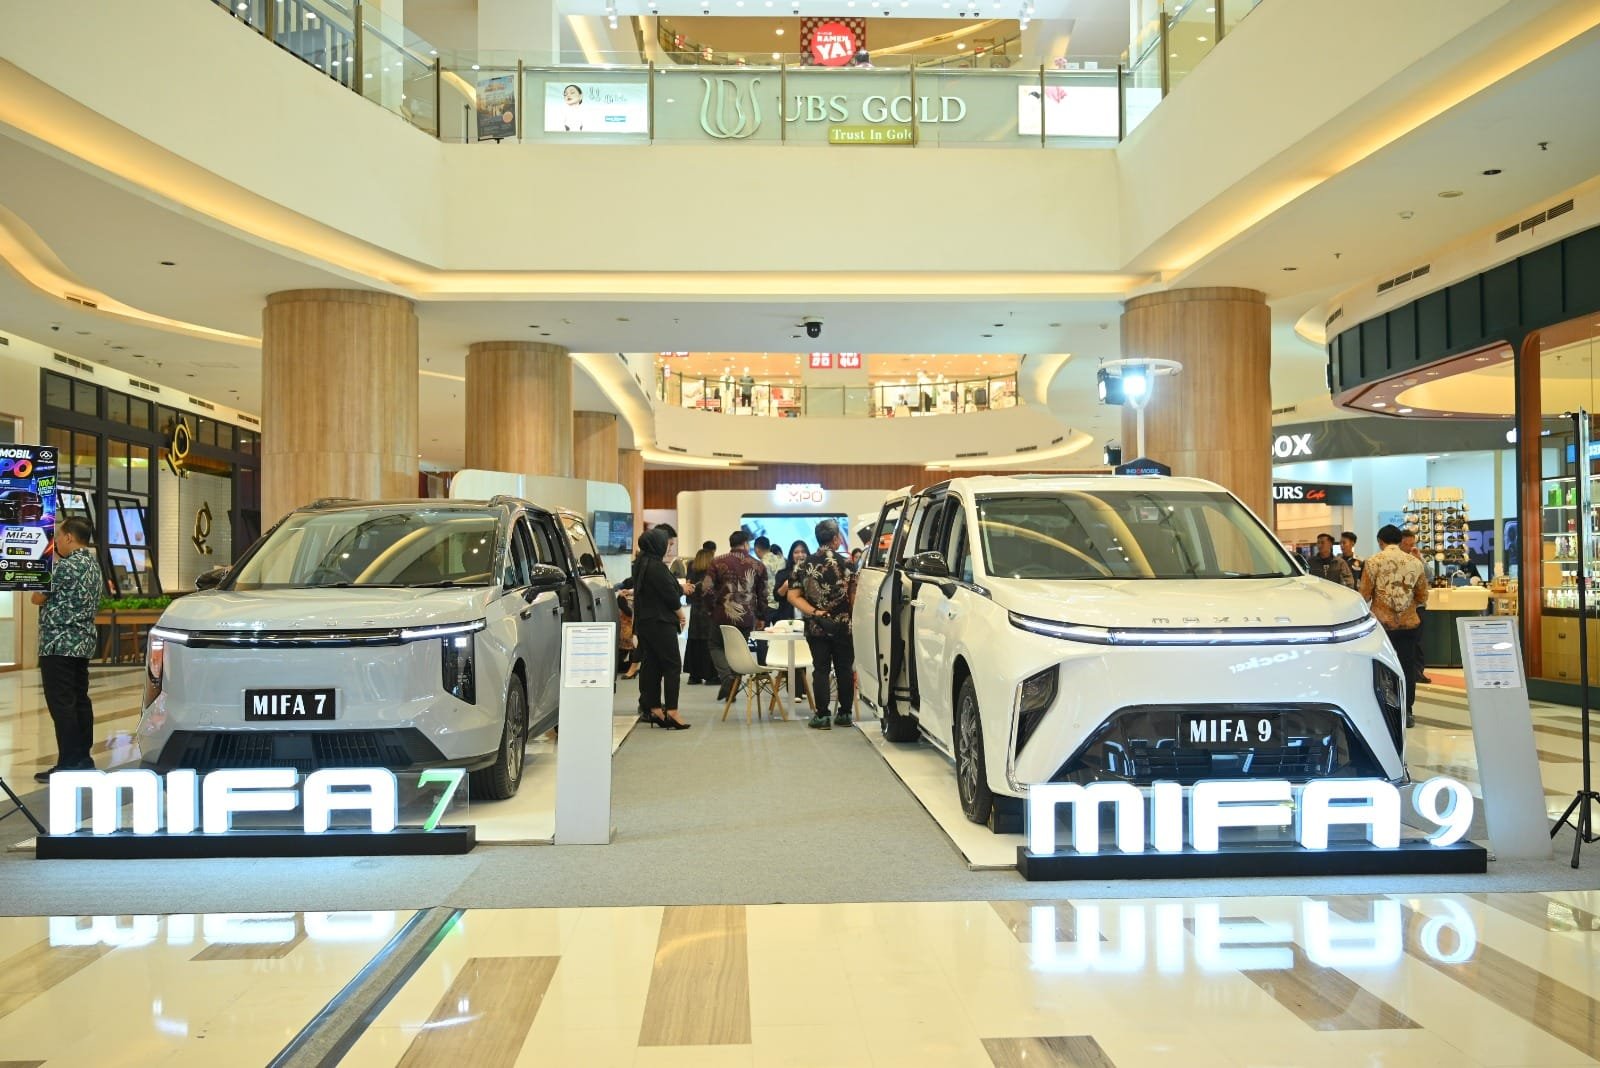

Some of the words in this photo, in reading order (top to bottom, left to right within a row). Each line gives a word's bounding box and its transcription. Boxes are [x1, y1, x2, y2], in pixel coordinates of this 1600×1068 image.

[816, 40, 853, 60] YA!
[817, 35, 849, 43] RAMEN
[776, 95, 849, 122] UBS
[861, 95, 968, 122] GOLD
[831, 128, 865, 140] Trust
[870, 128, 882, 140] In
[1272, 433, 1312, 458] OX
[253, 694, 306, 716] MIFA
[314, 694, 327, 715] 7
[1190, 719, 1249, 743] MIFA
[1257, 718, 1273, 743] 9
[49, 767, 399, 835] MIFA
[417, 768, 467, 832] 7
[1025, 778, 1402, 855] MIFA
[1412, 776, 1475, 847] 9
